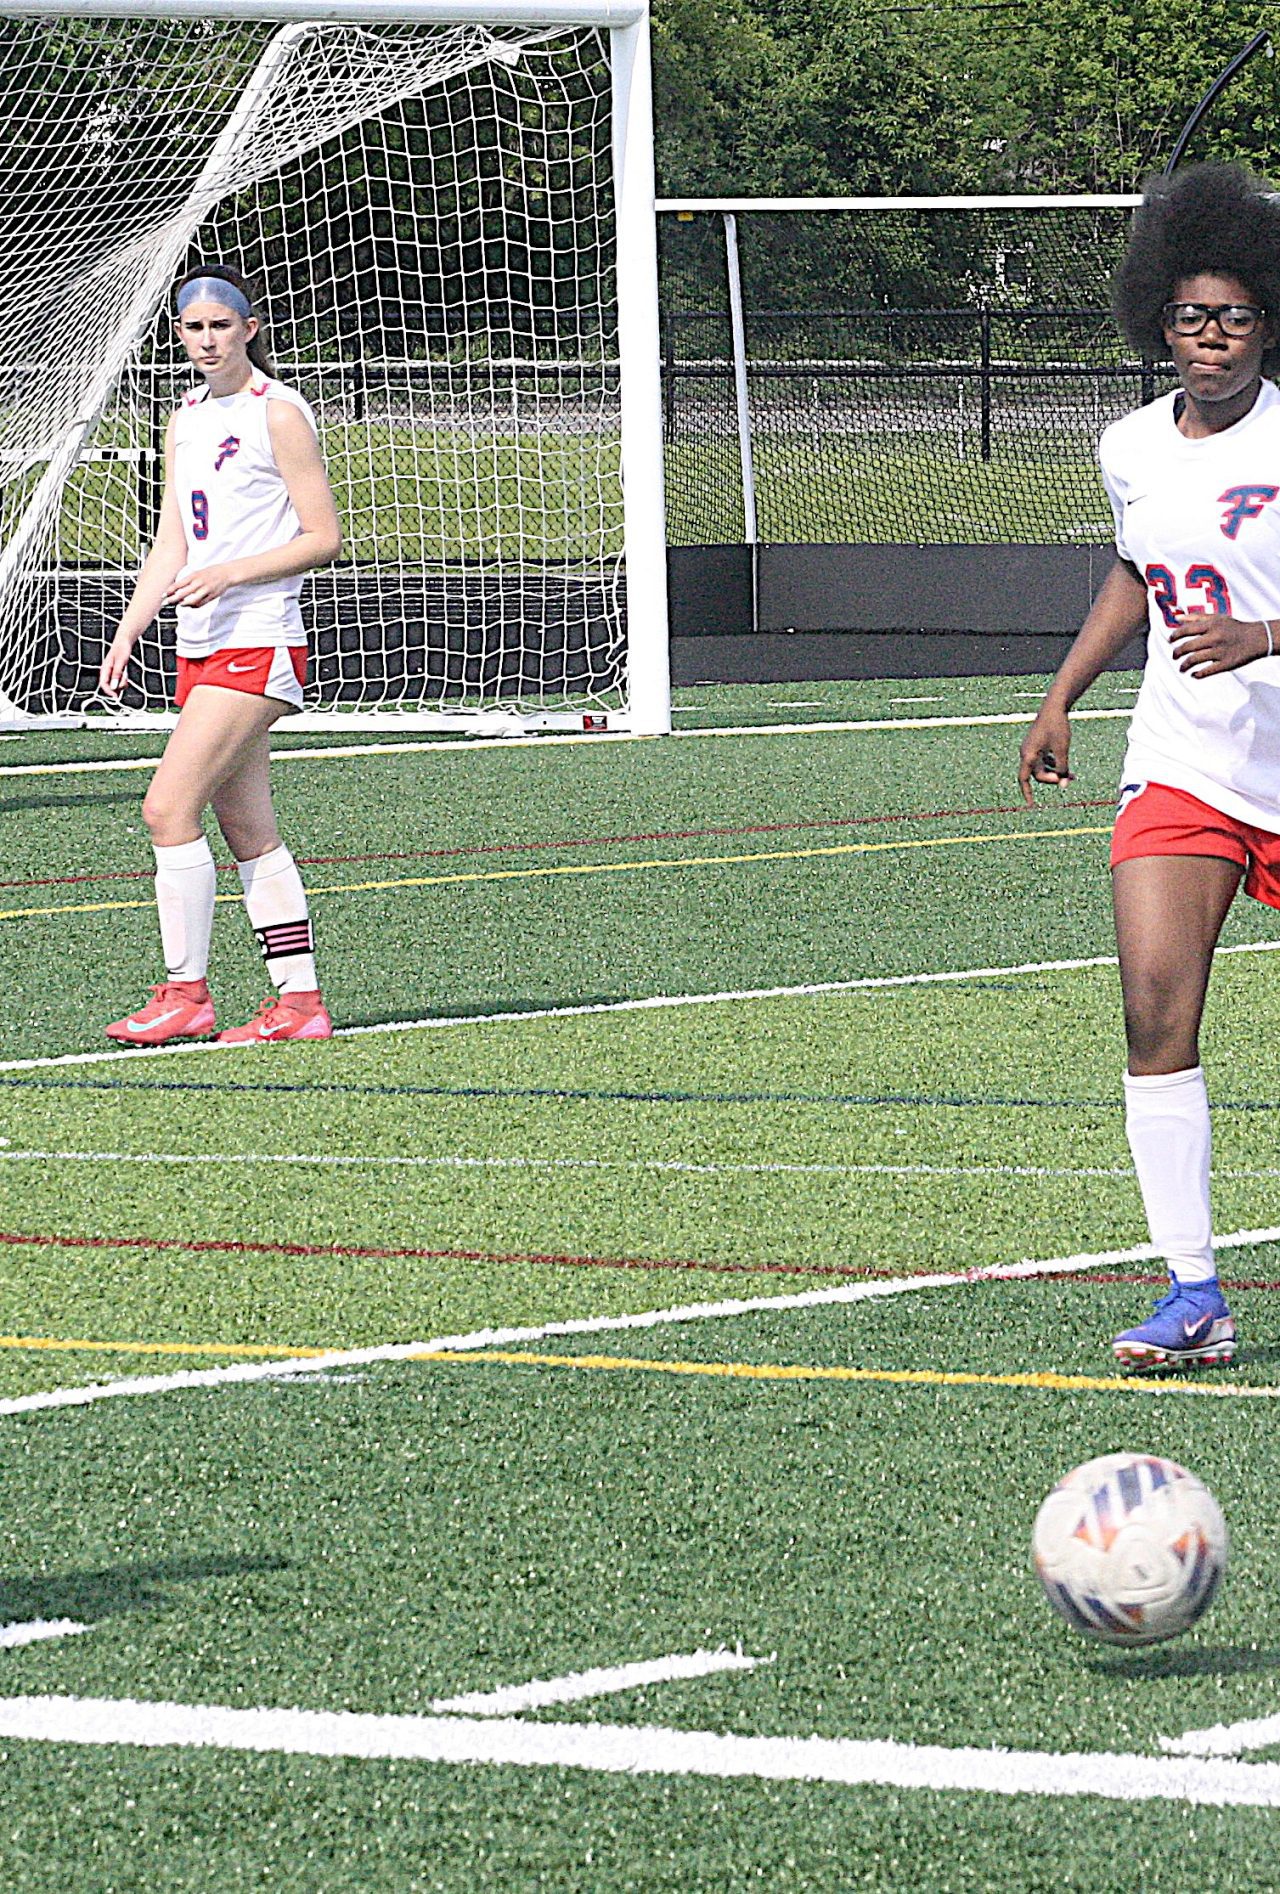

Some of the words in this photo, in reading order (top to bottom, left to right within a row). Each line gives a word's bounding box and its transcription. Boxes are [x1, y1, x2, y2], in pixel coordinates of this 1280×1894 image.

[191, 490, 209, 541] 9
[1216, 484, 1280, 541] F
[1145, 563, 1232, 628] 23
